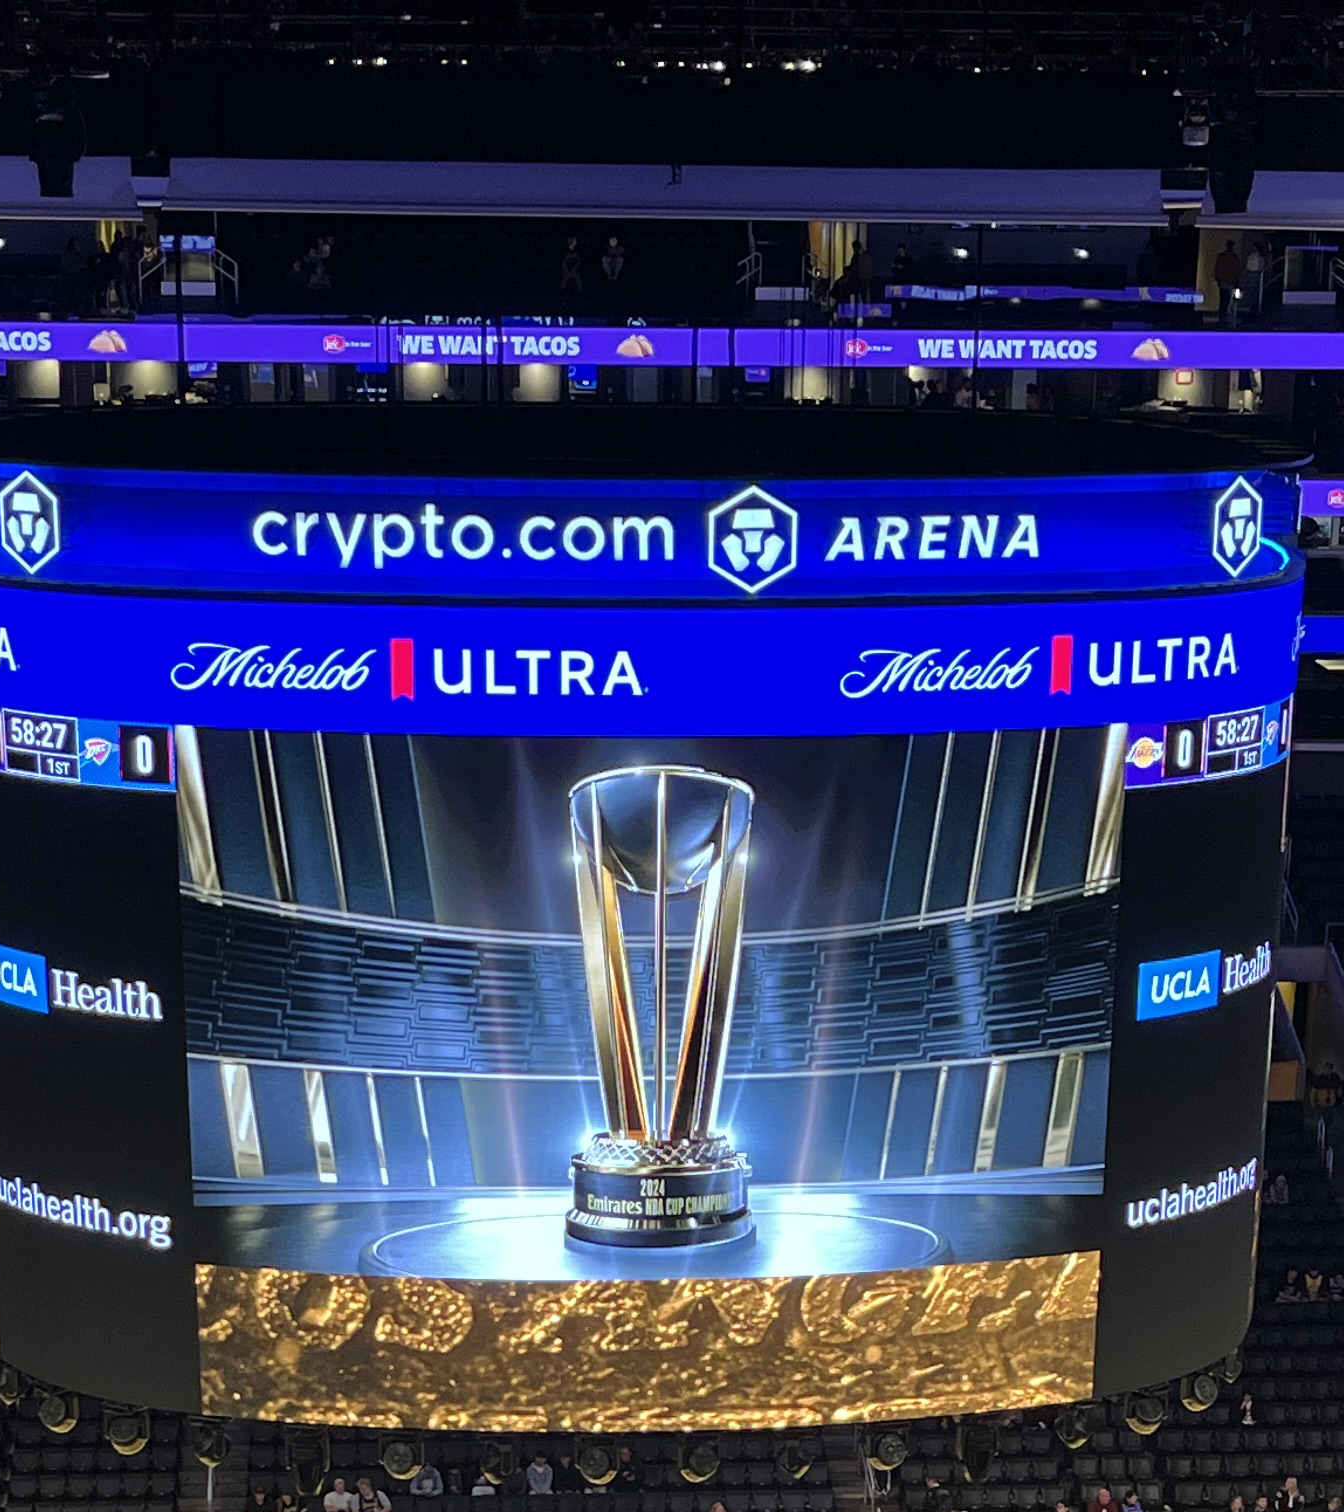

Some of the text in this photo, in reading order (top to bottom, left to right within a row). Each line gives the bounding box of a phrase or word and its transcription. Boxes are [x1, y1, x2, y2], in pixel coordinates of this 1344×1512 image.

[400, 334, 580, 357] WE WANT TACOS
[918, 338, 1098, 359] WE WANT TACOS
[253, 504, 1040, 569] crypto.com ARENA
[171, 642, 646, 696] Michelob ULTRA
[839, 646, 1041, 699] Michelob
[1088, 632, 1238, 687] ULTRA
[10, 717, 68, 750] 58:27
[1216, 714, 1260, 747] 58:27
[134, 735, 154, 775] 0
[1177, 729, 1193, 769] 0
[1243, 751, 1258, 766] 1ST
[47, 758, 71, 776] 1ST
[51, 967, 164, 1022] Health
[1151, 966, 1211, 1005] UCLA
[640, 1178, 666, 1197] 2024
[587, 1194, 684, 1216] Emirates NBA CUP
